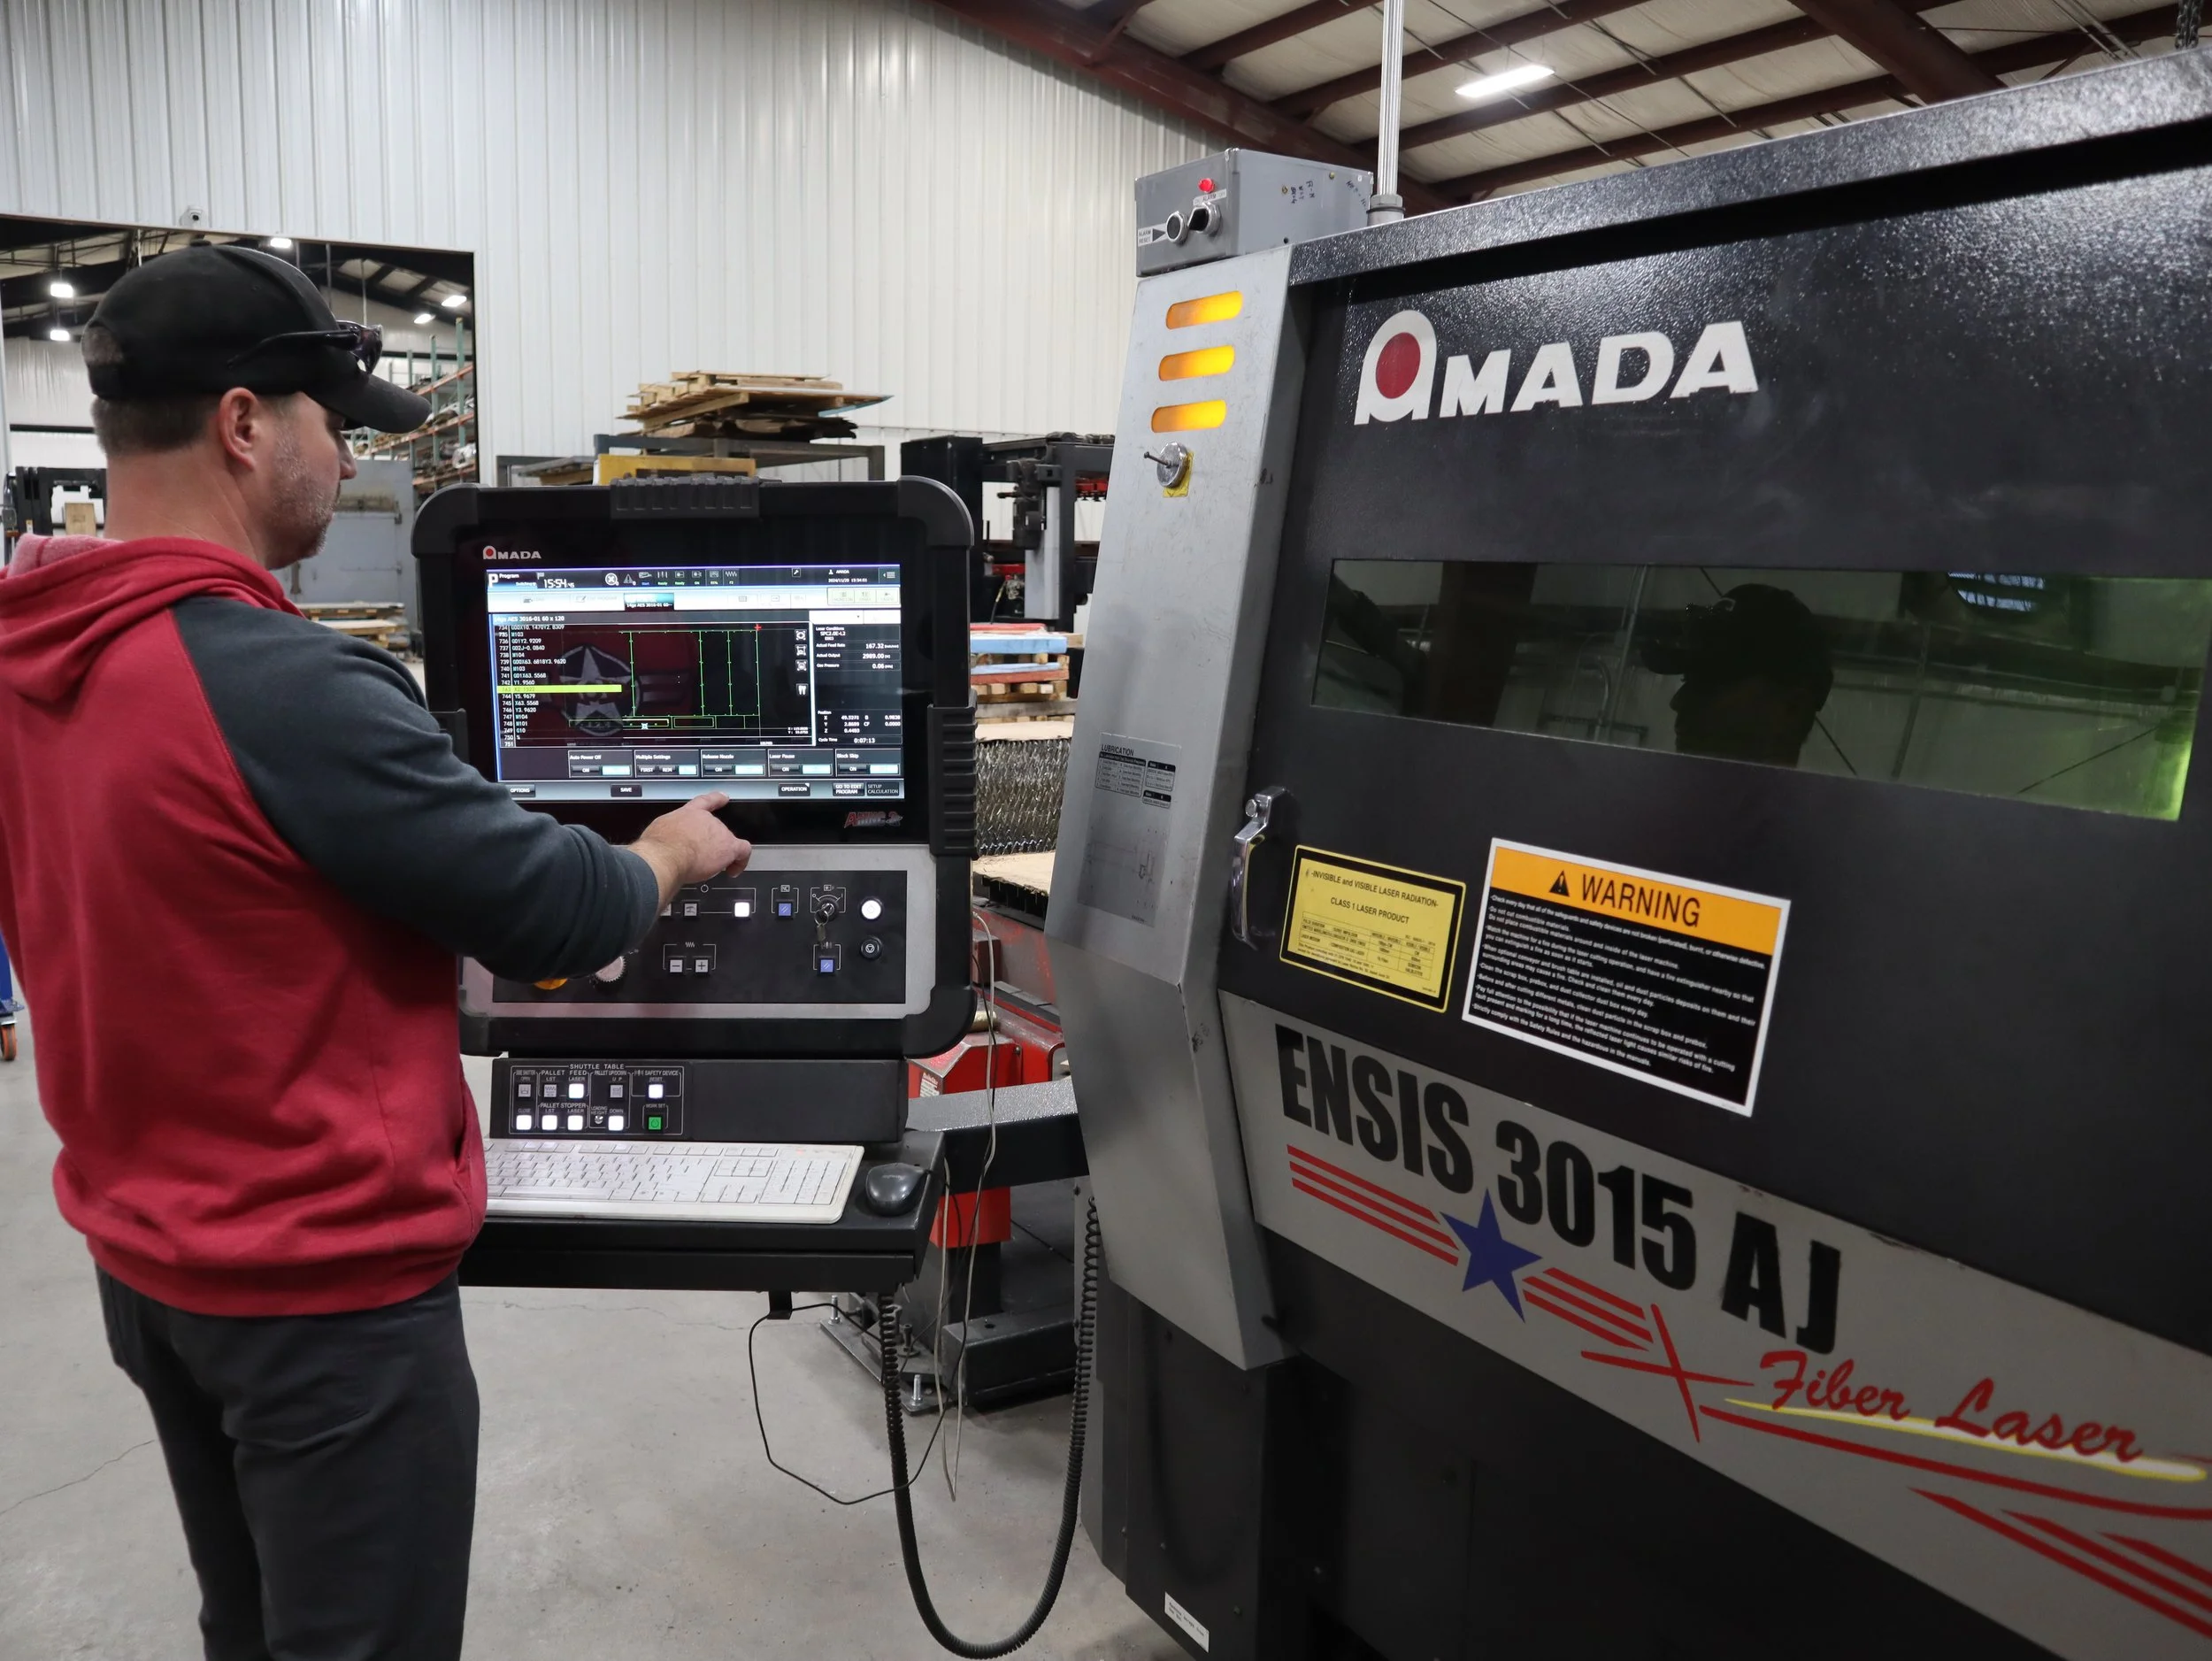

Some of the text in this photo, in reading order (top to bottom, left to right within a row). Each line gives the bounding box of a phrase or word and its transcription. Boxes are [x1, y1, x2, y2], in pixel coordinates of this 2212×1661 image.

[1354, 310, 1759, 425] AMADA
[483, 546, 541, 560] AMADA
[1101, 744, 1134, 756] LUBRICATION
[1330, 897, 1351, 909] CLASS
[1356, 905, 1377, 916] LASER
[1378, 908, 1409, 924] PRODUCT
[1354, 880, 1378, 893] VISIBLE
[1378, 888, 1400, 899] LASER
[1582, 873, 1701, 928] WARNING
[1481, 951, 1510, 965] surrounding
[1510, 959, 1524, 968] areas
[1524, 963, 1535, 973] may
[1535, 966, 1551, 976] cause
[1556, 972, 1566, 981] fire.
[1567, 975, 1584, 986] Check
[1584, 980, 1595, 989] and
[1595, 983, 1611, 993] clean
[1611, 988, 1626, 998] them
[1625, 992, 1642, 1004] every
[1642, 997, 1654, 1007] day.
[1502, 968, 1517, 979] scrap
[1517, 973, 1528, 983] box,
[1528, 976, 1548, 988] prebox,
[1548, 982, 1559, 990] and
[1559, 985, 1571, 994] dust
[1571, 989, 1595, 1001] collector
[1595, 996, 1608, 1005] dust
[1609, 1000, 1620, 1009] box
[1620, 1003, 1636, 1015] every
[1636, 1008, 1648, 1018] day.
[1494, 977, 1707, 1049] and after cutting different metals, clean dust particle in the scrap box and prebox.
[1274, 1023, 1840, 1355] ENSIS 3015 AJ
[1760, 1350, 2143, 1463] Fiber Laser
